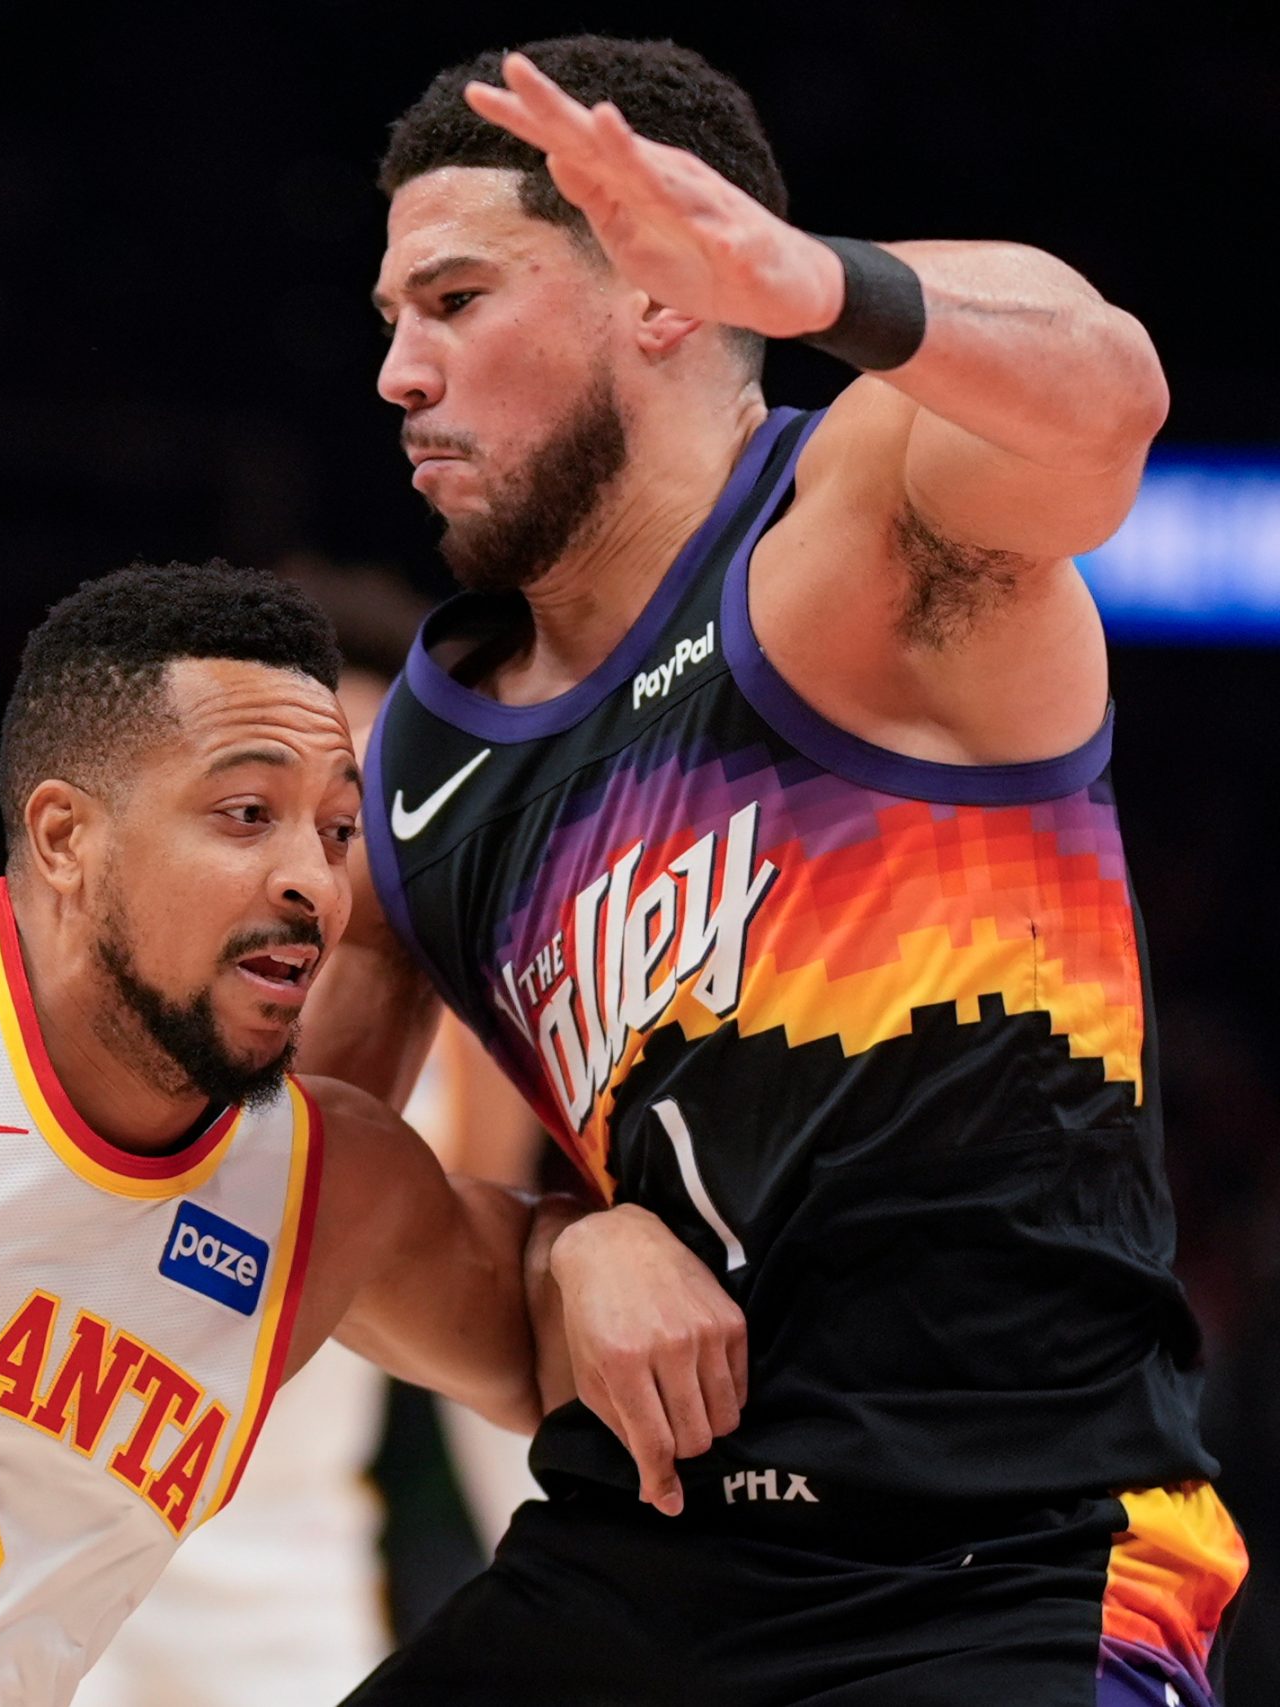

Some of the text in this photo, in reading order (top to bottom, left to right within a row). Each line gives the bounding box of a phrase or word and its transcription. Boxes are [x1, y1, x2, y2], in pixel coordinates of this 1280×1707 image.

[632, 620, 715, 710] PayPal
[518, 930, 565, 1006] THE
[650, 1097, 748, 1272] 1
[169, 1222, 258, 1287] paze
